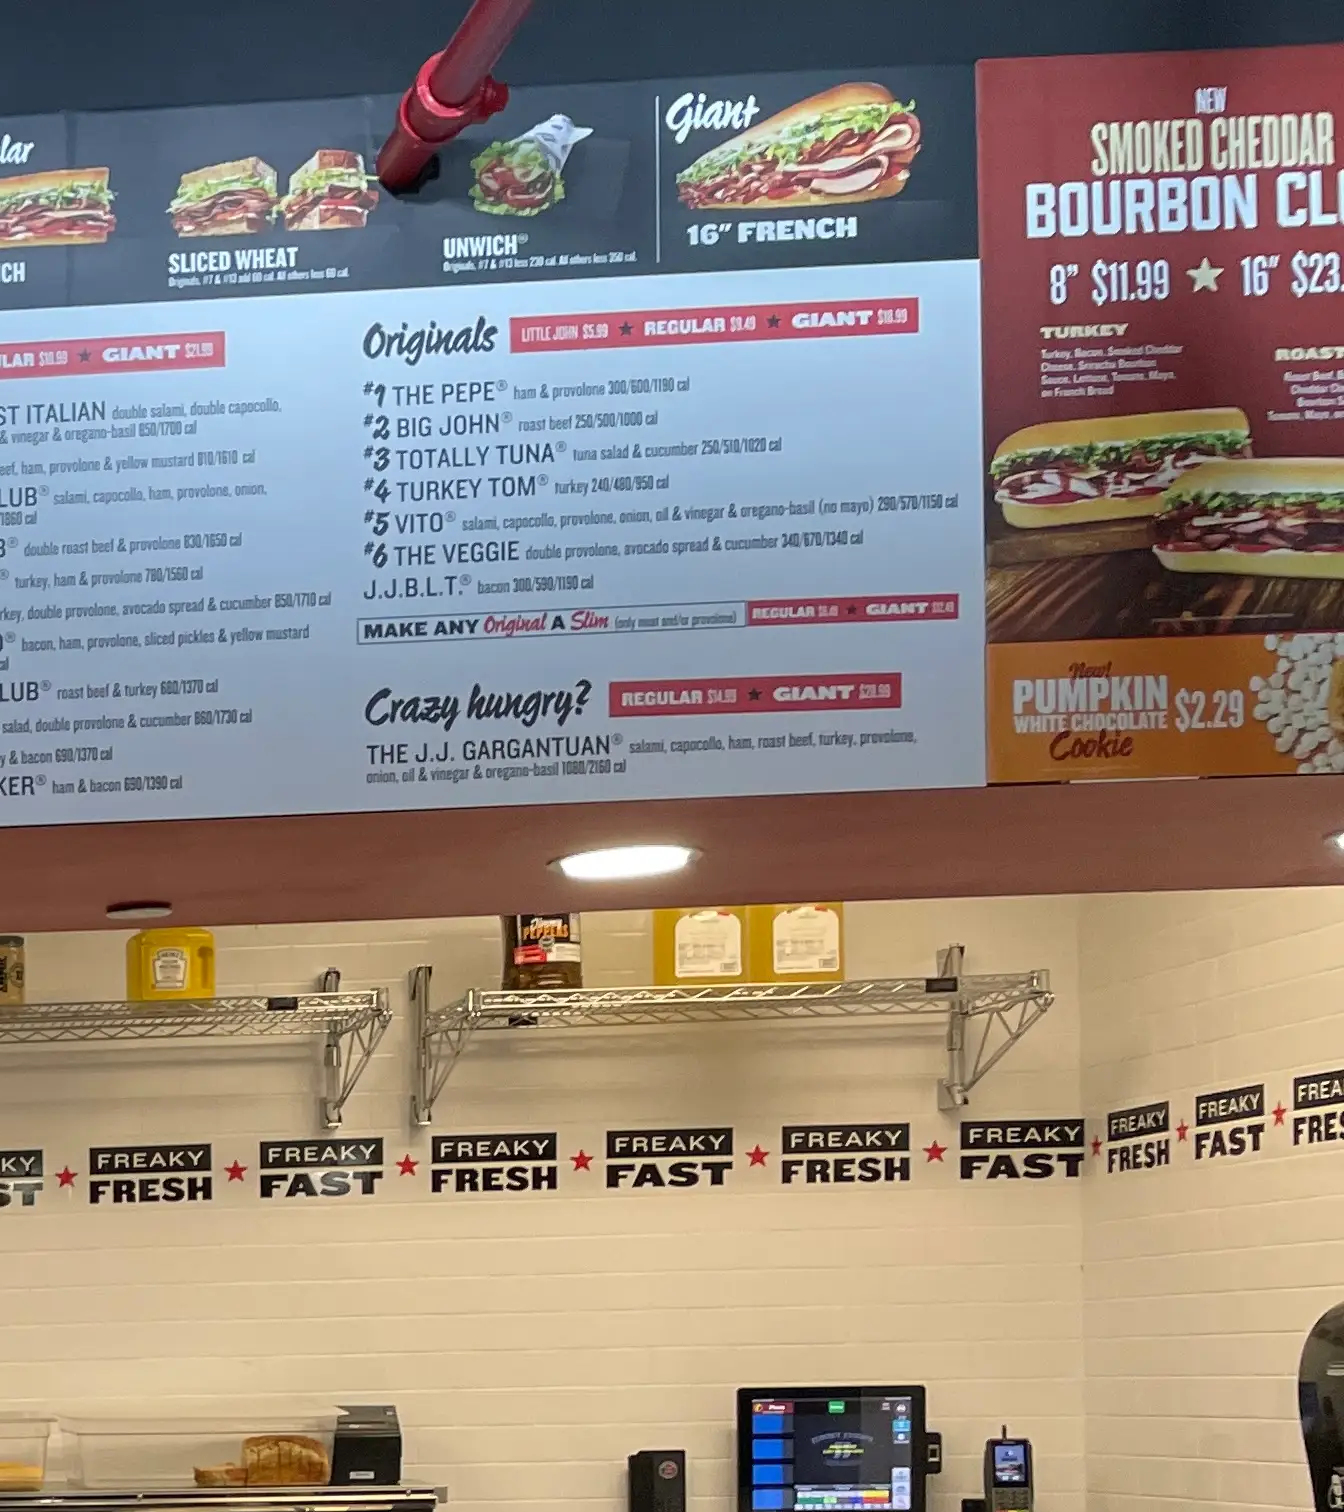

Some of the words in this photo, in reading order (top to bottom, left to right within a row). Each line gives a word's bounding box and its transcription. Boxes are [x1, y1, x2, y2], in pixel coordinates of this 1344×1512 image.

[1195, 87, 1227, 114] NEW
[666, 93, 760, 143] Giant
[1091, 119, 1204, 176] SMOKED
[1211, 112, 1335, 170] CHEDDAR
[1026, 173, 1258, 238] BOURBON
[1276, 169, 1344, 228] CL
[738, 217, 857, 243] FRENCH
[168, 251, 231, 274] SLICED
[236, 247, 298, 269] WHEAT
[1092, 259, 1170, 306] $11.99
[644, 316, 725, 335] REGULAR
[791, 309, 873, 329] GIANT
[1040, 323, 1128, 339] TURKEY
[363, 317, 497, 364] Originals
[26, 401, 106, 424] ITALIAN
[396, 416, 432, 438] BIG
[394, 544, 435, 567] THE
[441, 541, 519, 564] VEGGIE
[53, 574, 75, 589] ham
[91, 571, 142, 589] provolone
[364, 620, 427, 639] MAKE
[433, 617, 480, 636] ANY
[483, 612, 546, 637] Original
[551, 615, 565, 630] A
[570, 610, 608, 632] Slim
[1068, 662, 1111, 679] New!
[365, 686, 458, 731] Crazy
[466, 678, 592, 727] hungry?
[1014, 675, 1168, 714] PUMPKIN
[1014, 713, 1066, 733] WHITE
[1071, 711, 1168, 732] CHOCOLATE
[1174, 688, 1244, 732] $2.29
[366, 744, 408, 765] THE
[415, 741, 452, 763] J.J.
[1049, 730, 1134, 760] Cookie
[1111, 1110, 1165, 1135] FREAKY
[440, 1139, 550, 1157] FREAKY
[1108, 1139, 1169, 1174] FRESH
[432, 1164, 557, 1193] FRESH
